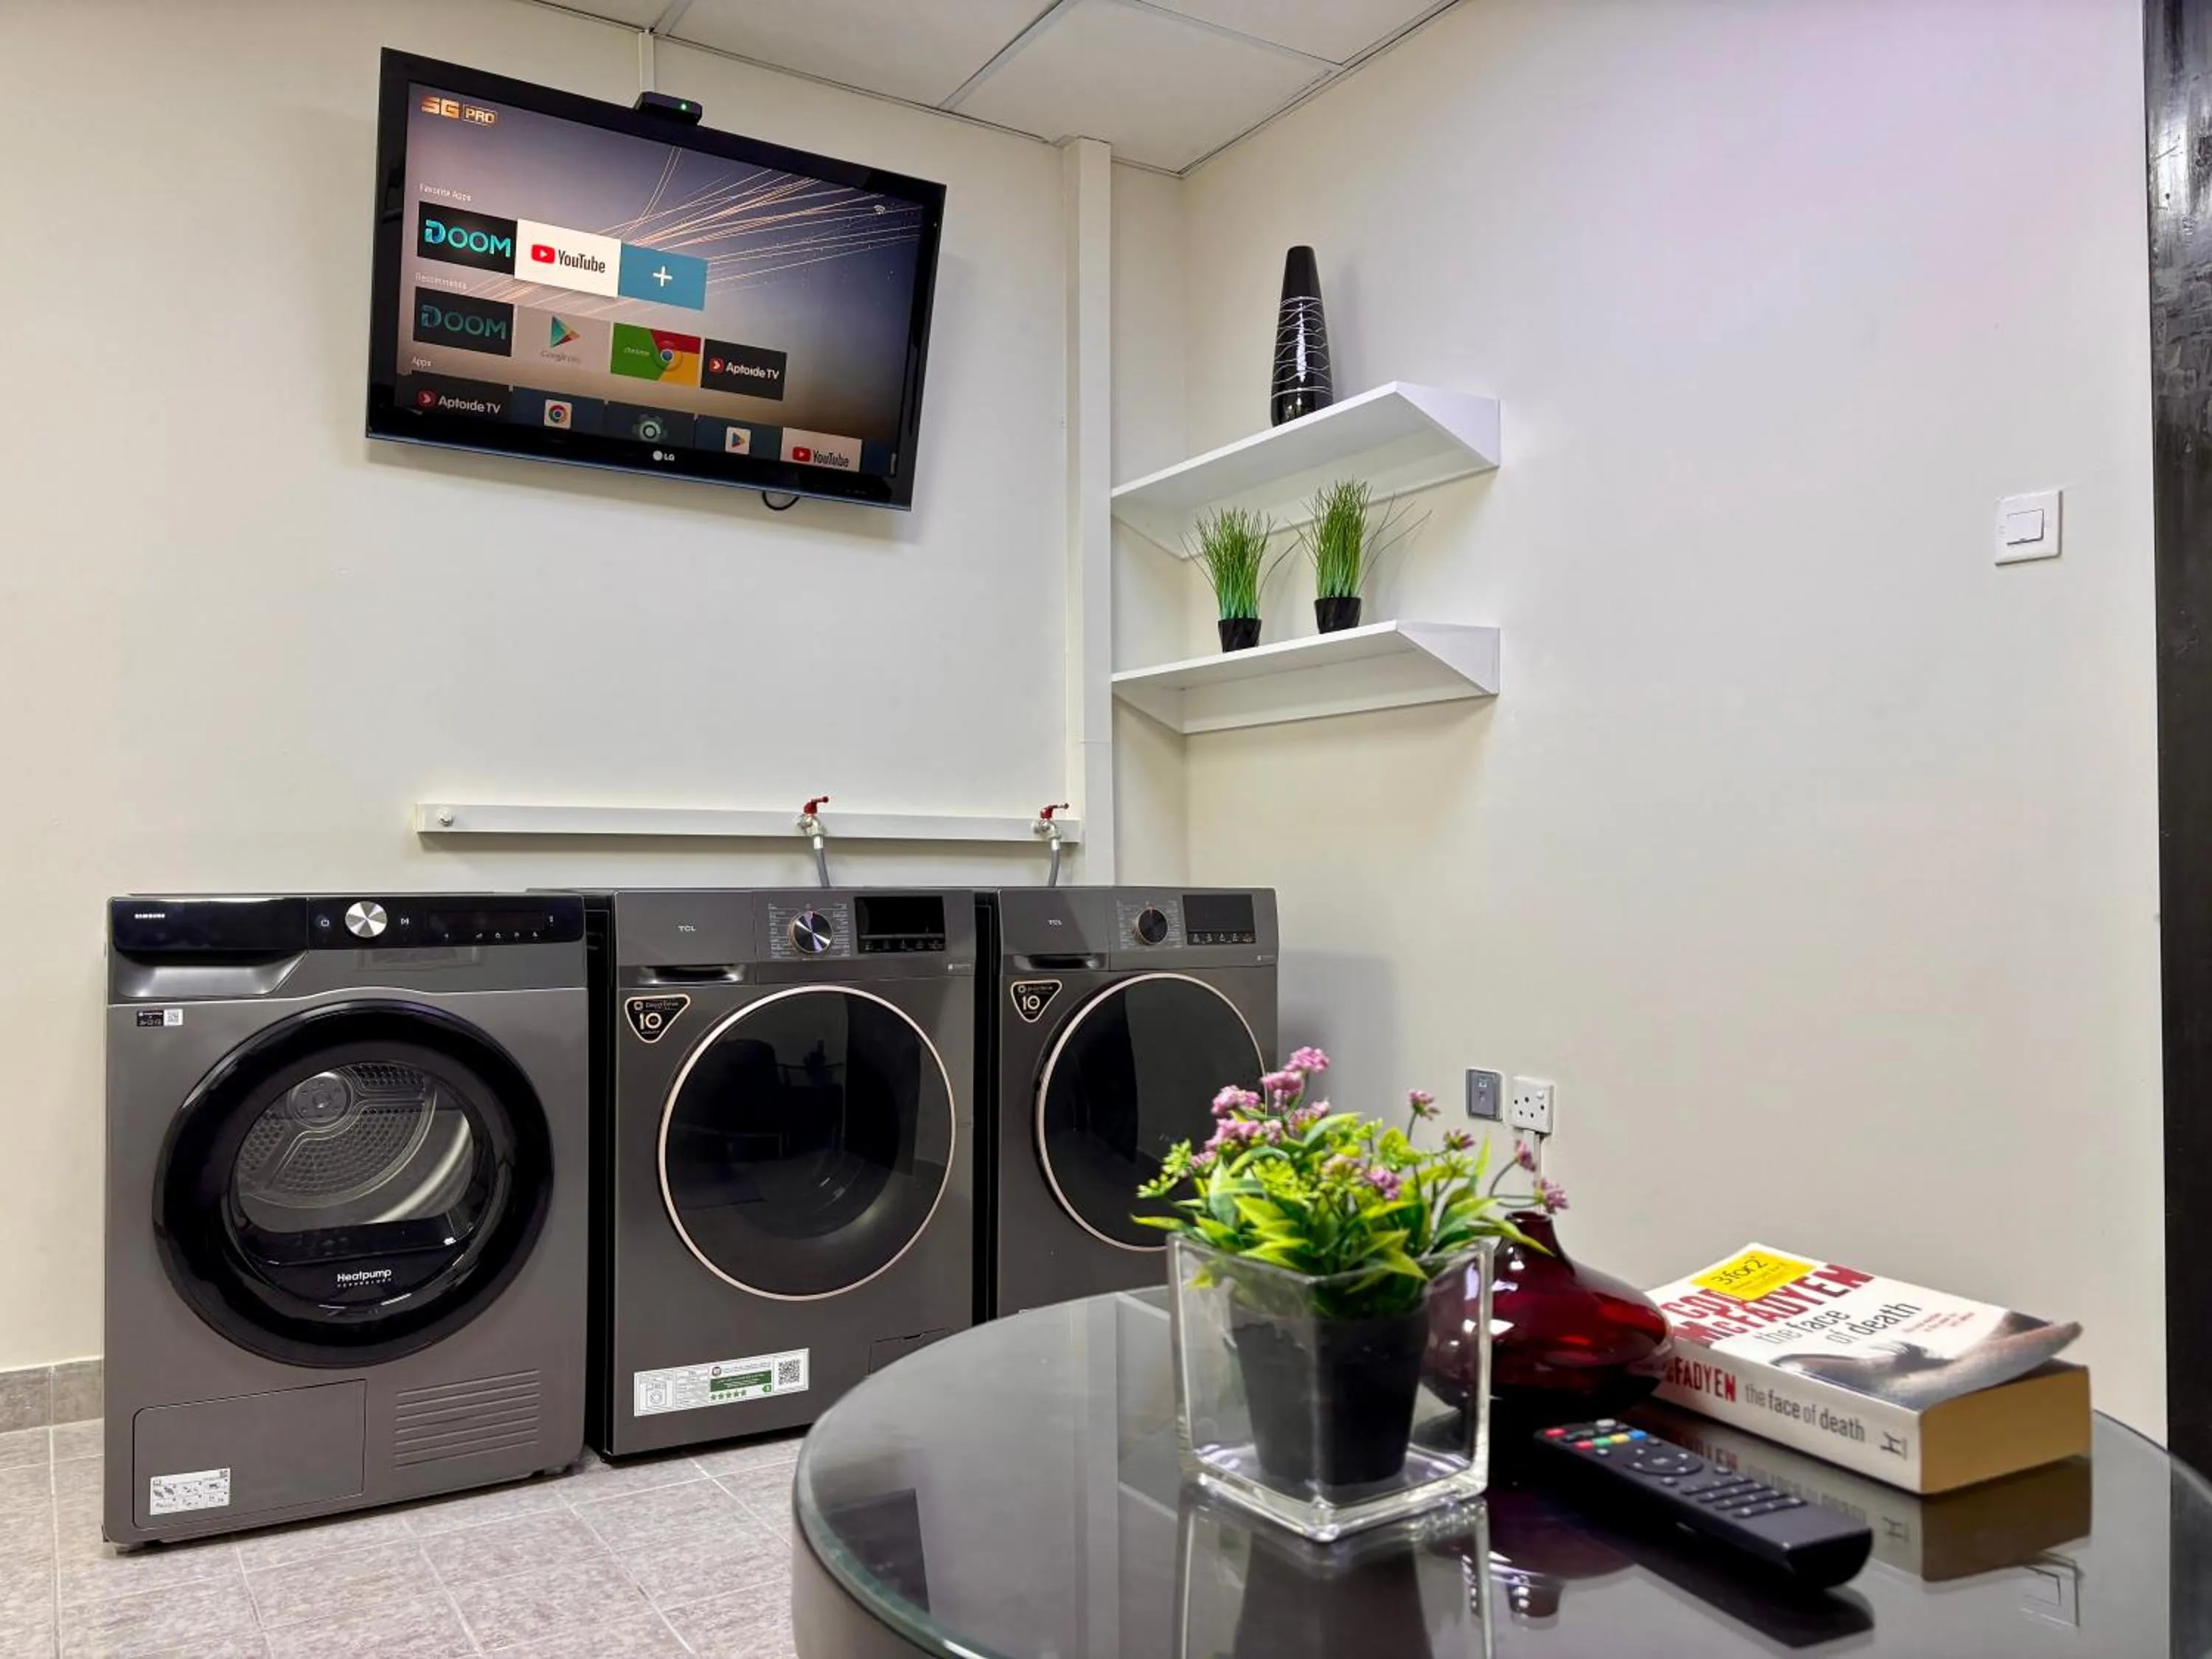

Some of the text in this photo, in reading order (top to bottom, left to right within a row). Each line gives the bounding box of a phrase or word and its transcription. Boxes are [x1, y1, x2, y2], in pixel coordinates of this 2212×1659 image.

[465, 108, 495, 124] PRO
[425, 220, 511, 257] DOOM
[558, 249, 605, 274] YouTube
[420, 305, 507, 340] DOOM
[726, 361, 779, 380] Aptoide TV
[438, 394, 501, 414] Aptoide TV
[813, 450, 849, 467] YouTube
[639, 1012, 662, 1030] 10
[337, 1269, 392, 1282] Heatpump
[1753, 1310, 1851, 1345] the face
[1826, 1328, 1858, 1345] of
[1845, 1302, 1922, 1336] death
[1745, 1382, 1766, 1407] the
[1768, 1390, 1800, 1419] face
[1803, 1403, 1816, 1425] of
[1820, 1408, 1865, 1442] death
